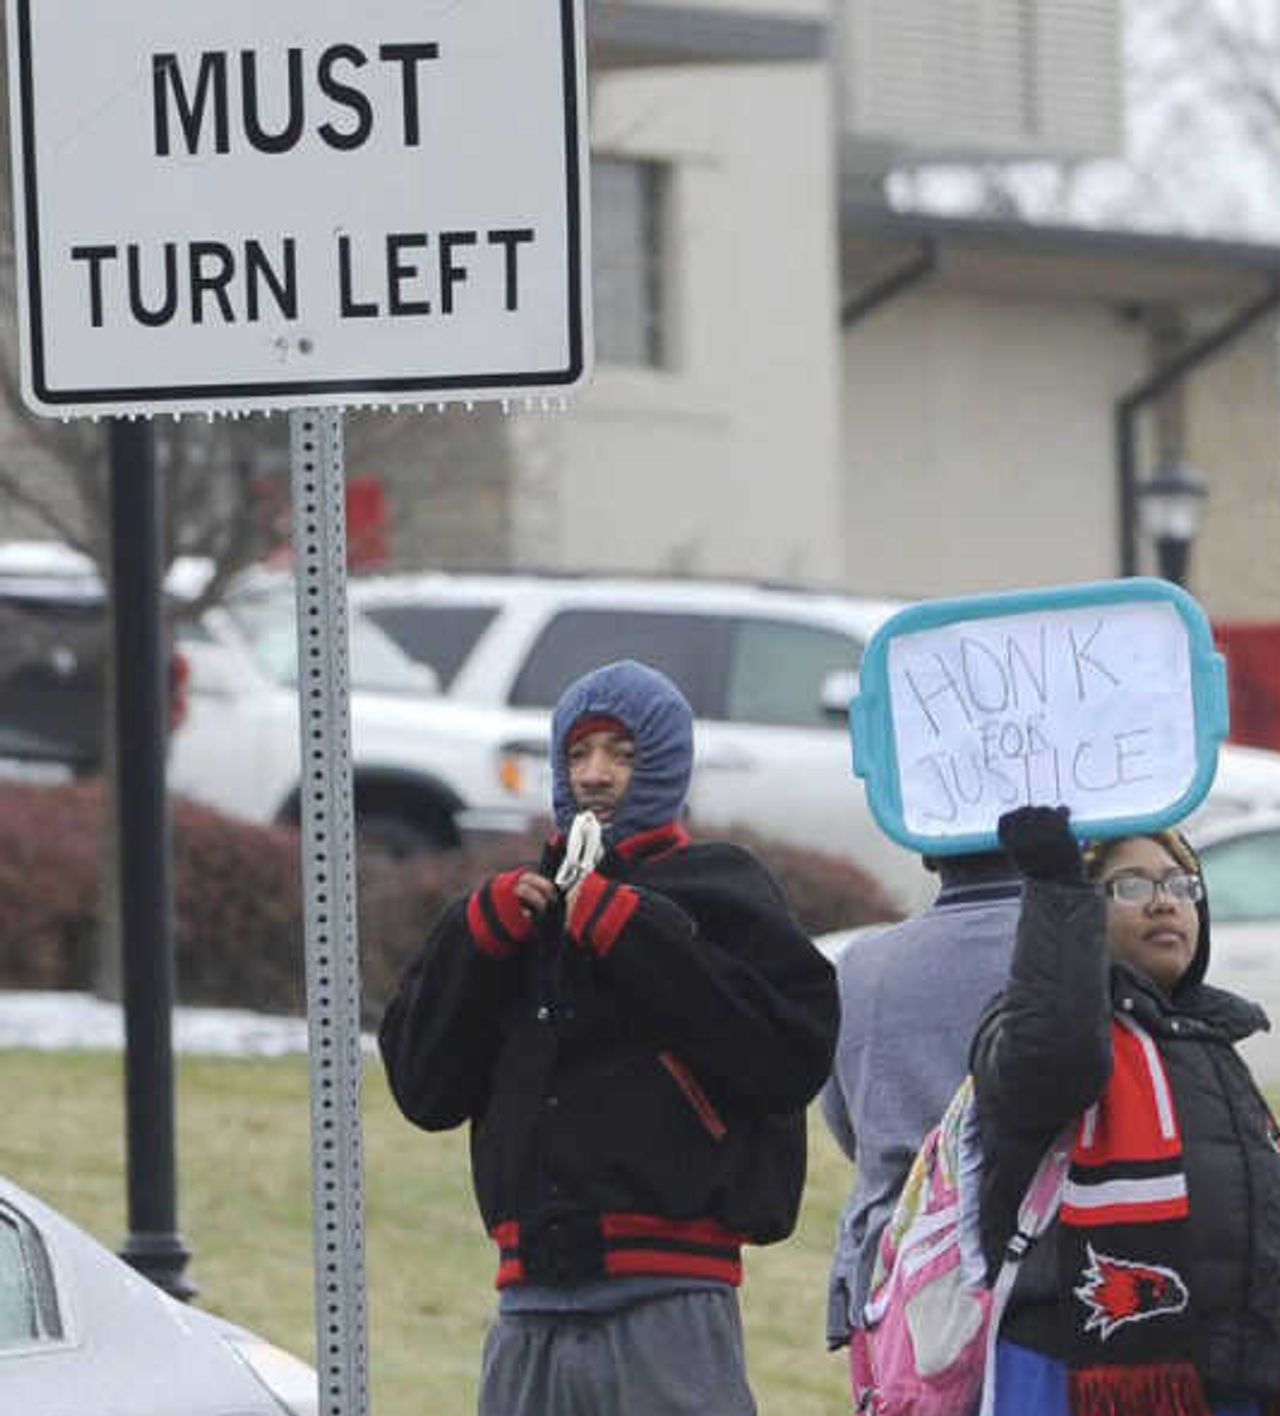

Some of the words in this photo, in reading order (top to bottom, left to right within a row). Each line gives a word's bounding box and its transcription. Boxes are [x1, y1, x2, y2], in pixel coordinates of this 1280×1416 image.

[153, 42, 439, 157] MUST
[71, 238, 298, 328] TURN
[338, 228, 535, 319] LEFT
[903, 617, 1120, 736] HONK
[917, 727, 1153, 823] JUSTICE
[979, 713, 1050, 768] FOR
